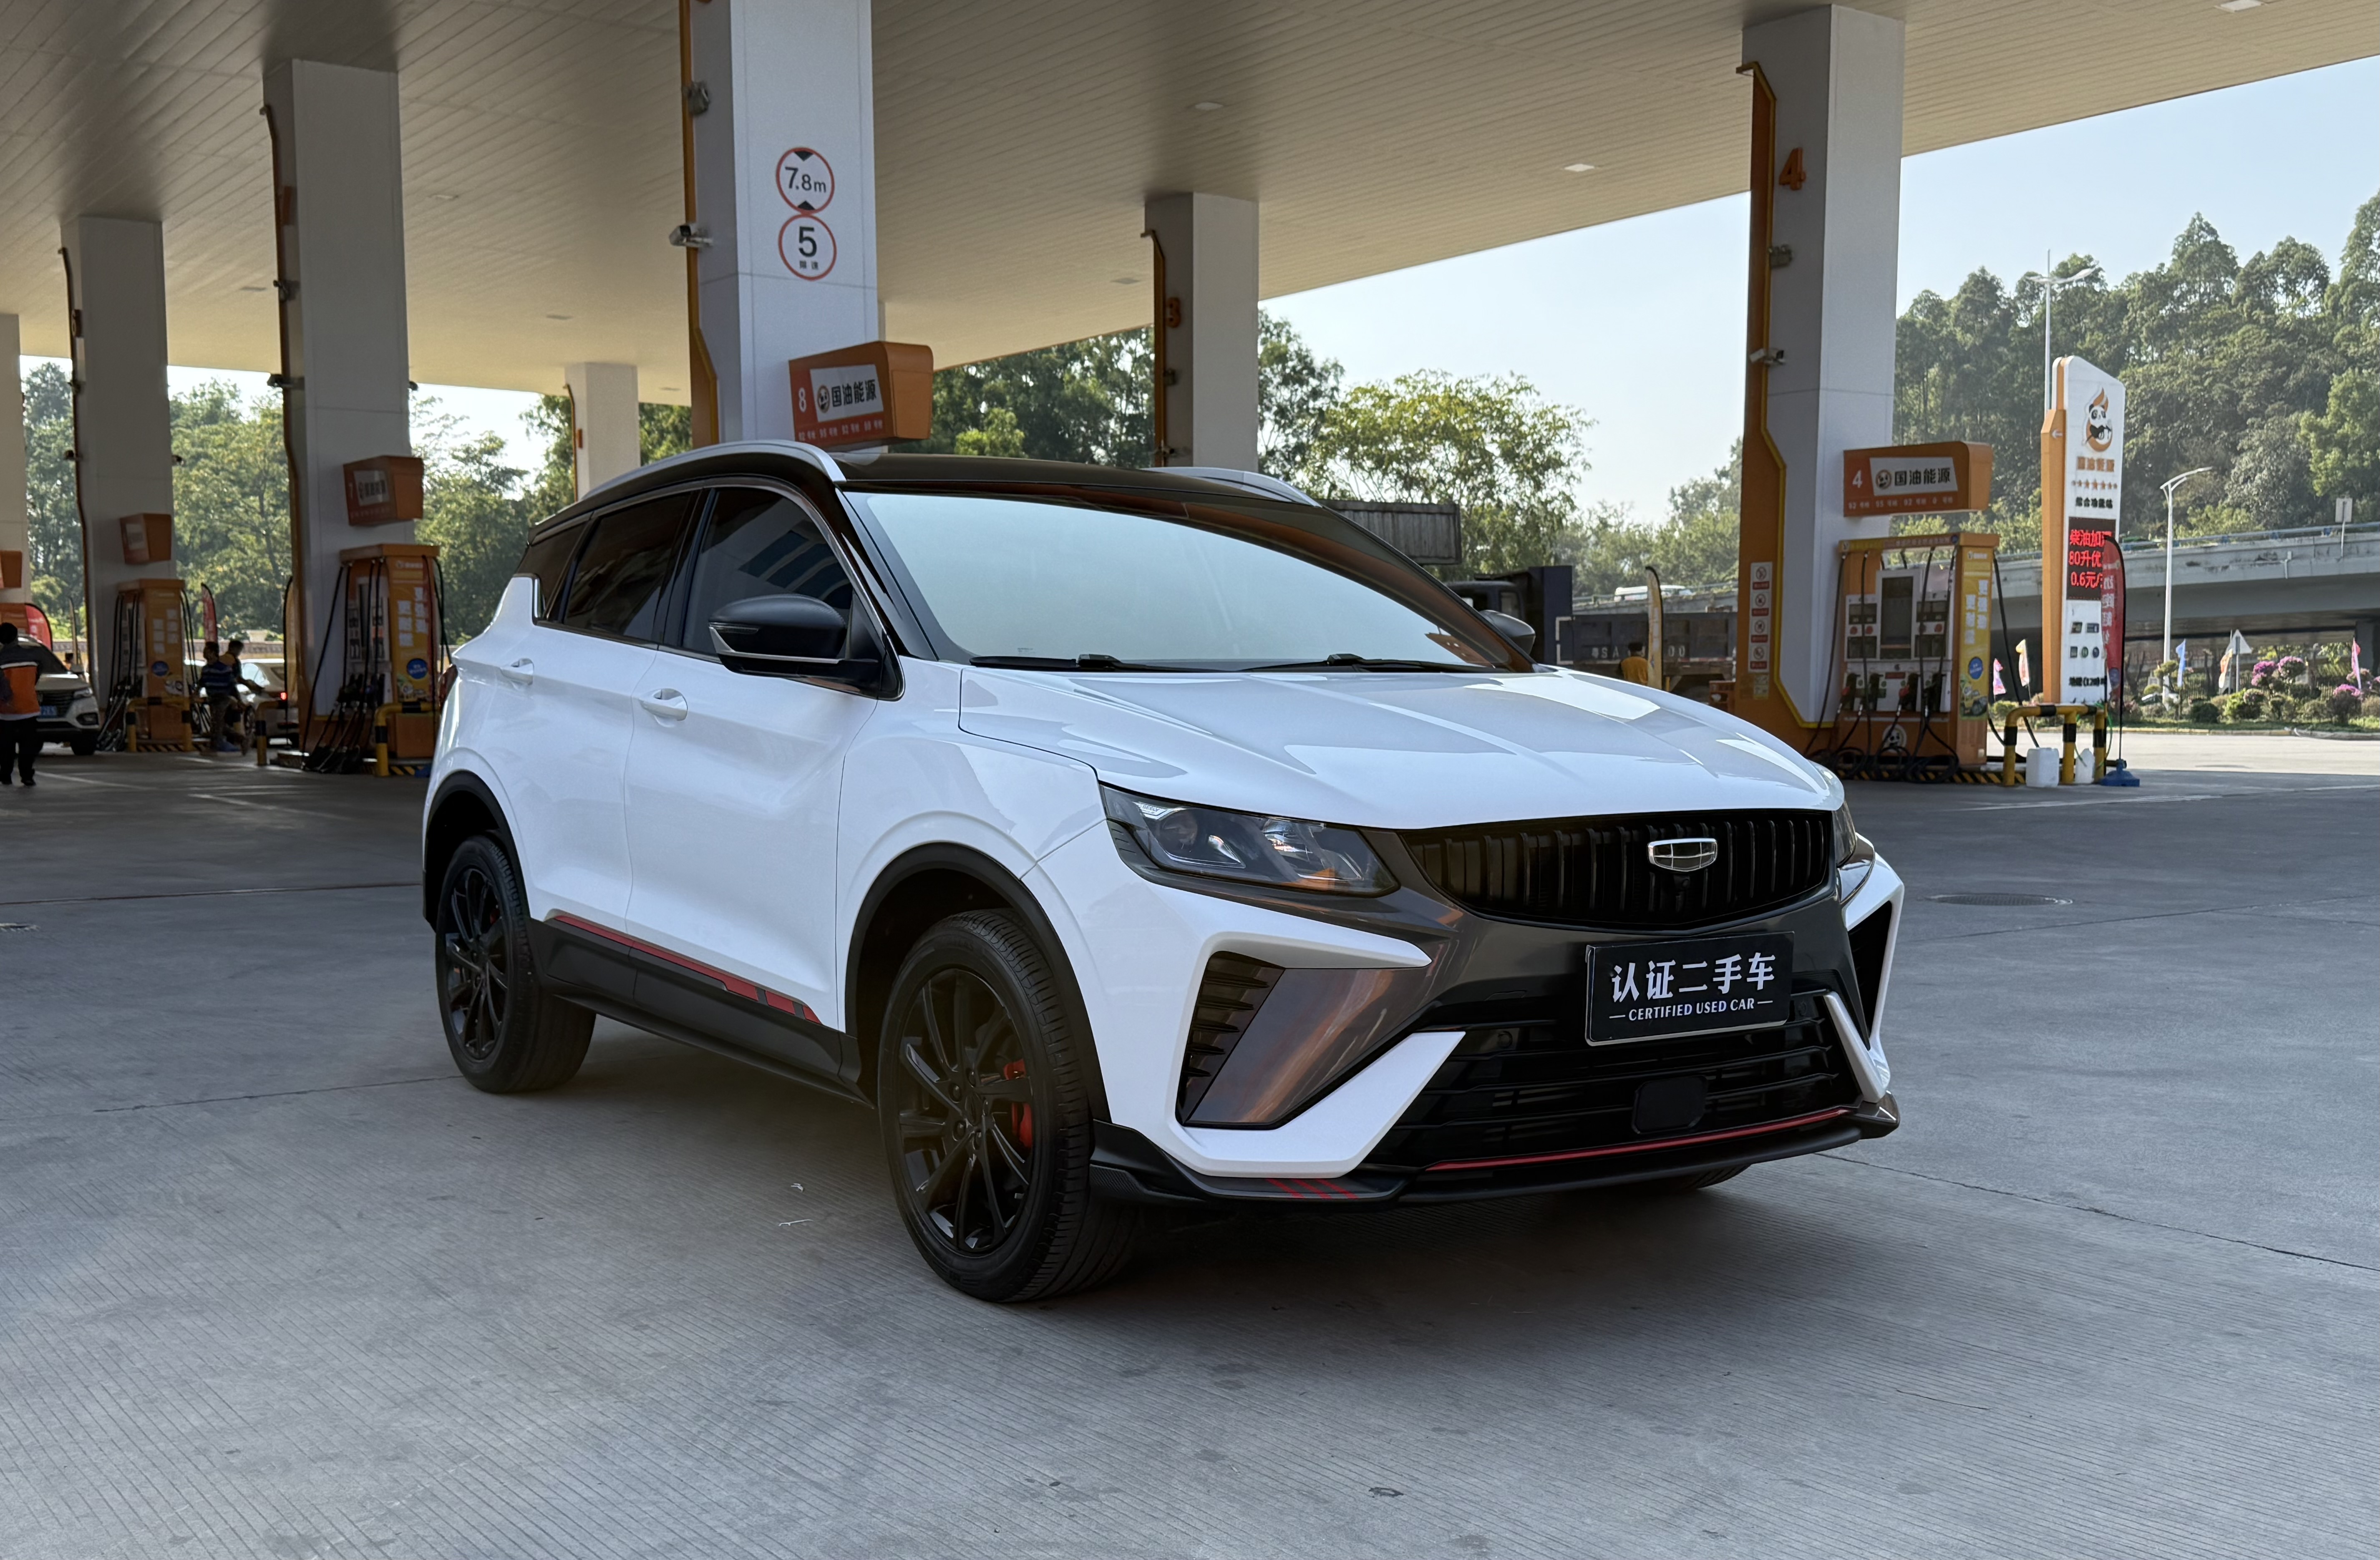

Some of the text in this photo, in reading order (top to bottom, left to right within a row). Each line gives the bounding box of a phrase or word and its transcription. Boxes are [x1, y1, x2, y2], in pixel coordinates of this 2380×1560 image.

[785, 166, 826, 193] 7.8m
[1779, 147, 1806, 191] 4
[798, 226, 817, 257] 5
[798, 387, 807, 413] 8
[831, 379, 876, 407] 国油能源
[1852, 470, 1863, 488] 4
[1894, 468, 1951, 486] 国油能源
[2069, 551, 2103, 567] 80升优
[2071, 571, 2103, 588] 0.6元/
[1612, 952, 1776, 1002] 认证二手车
[1628, 998, 1755, 1021] CERTIFIED USED CAR
